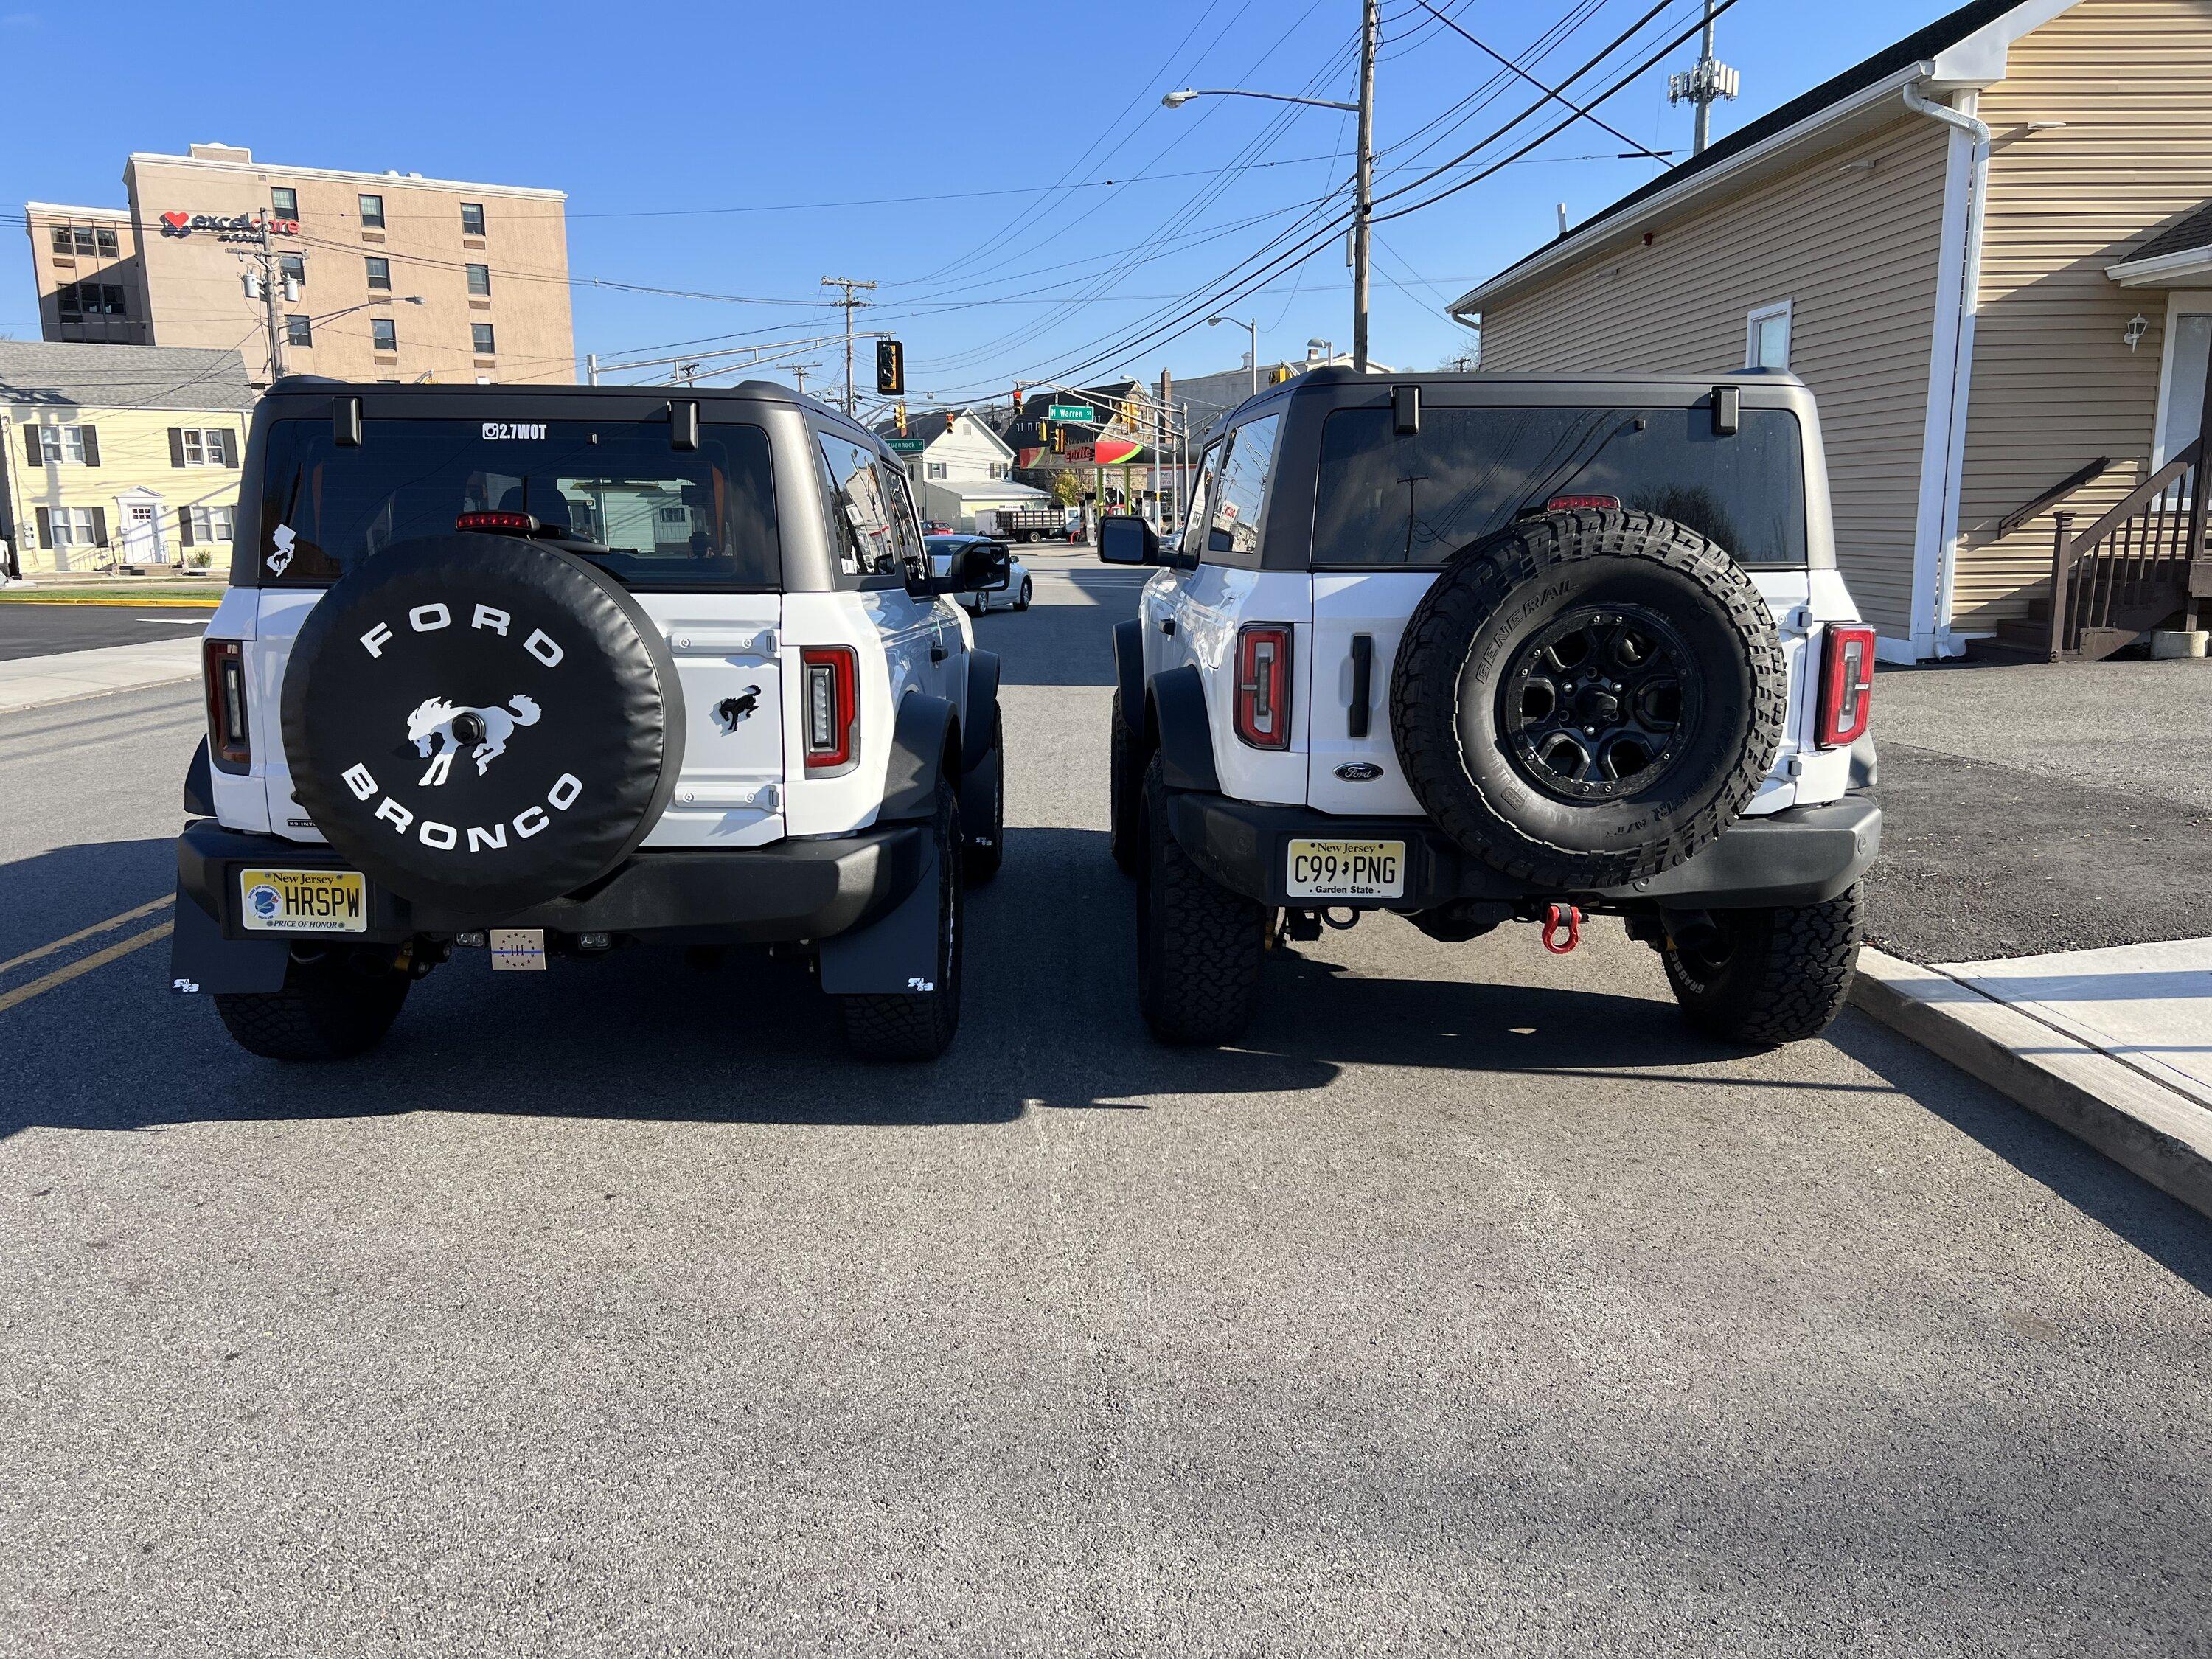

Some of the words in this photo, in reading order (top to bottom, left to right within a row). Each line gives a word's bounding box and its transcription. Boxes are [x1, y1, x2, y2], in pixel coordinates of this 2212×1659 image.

[1051, 408, 1056, 417] N
[1060, 408, 1083, 418] Warren
[359, 602, 564, 668] FORD
[1476, 579, 1579, 685] GENERAL
[1344, 766, 1372, 778] Ford
[341, 762, 583, 853] BRONCO
[1318, 843, 1342, 852] New
[1343, 843, 1377, 855] Jersey
[273, 872, 299, 883] New
[300, 873, 334, 886] Jersey
[1295, 855, 1338, 883] C99
[1353, 856, 1396, 884] PNG
[285, 886, 360, 917] HRSPW
[1315, 886, 1347, 894] Garden
[1669, 950, 1705, 994] GRABBE
